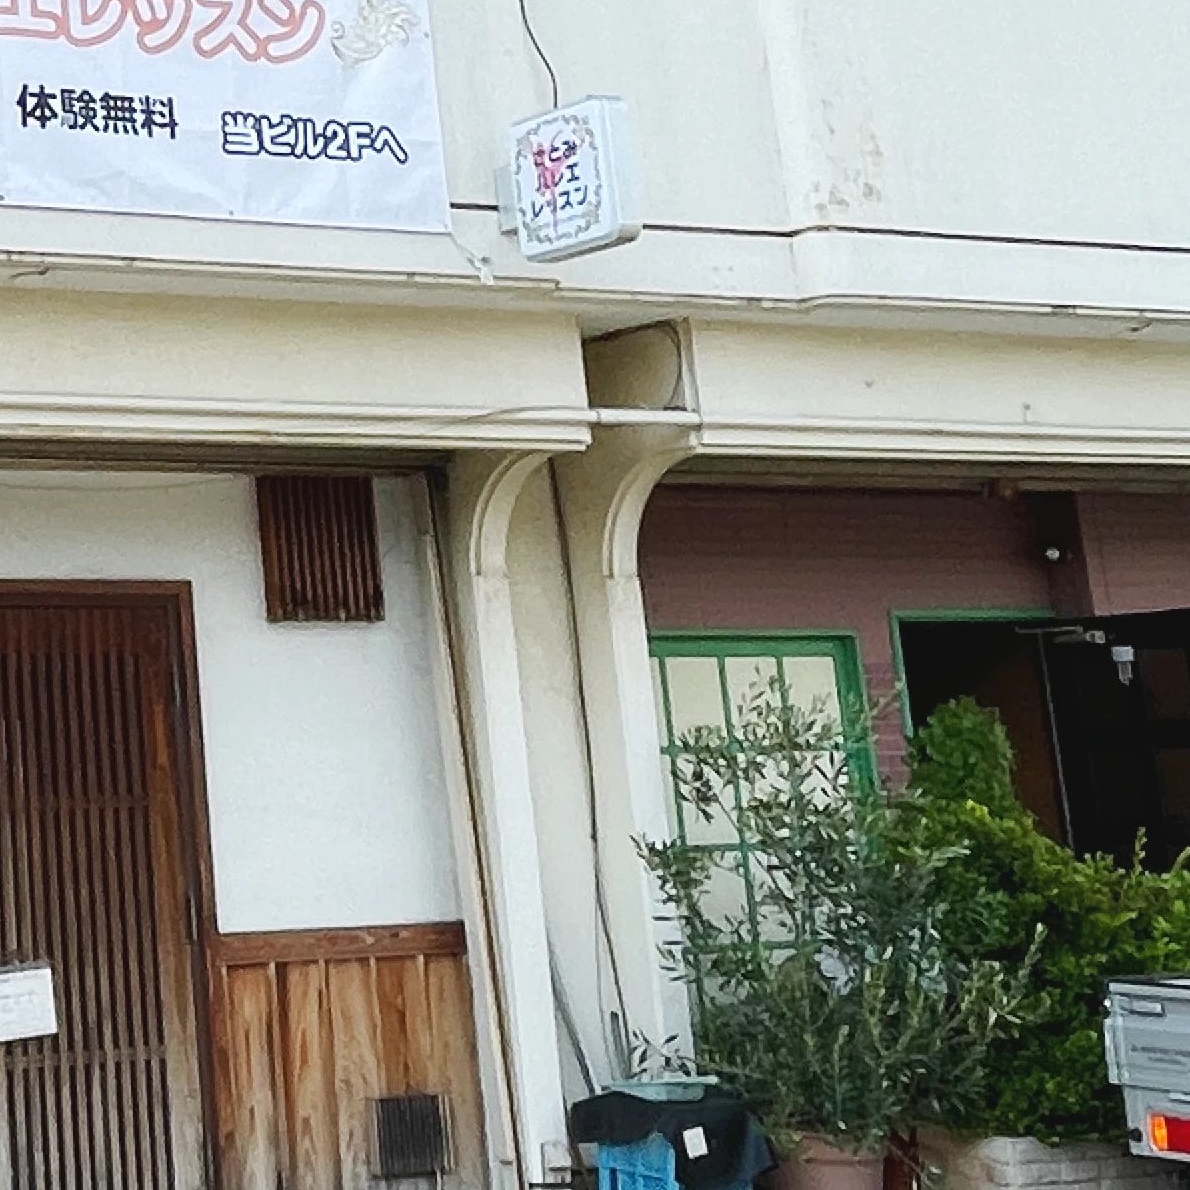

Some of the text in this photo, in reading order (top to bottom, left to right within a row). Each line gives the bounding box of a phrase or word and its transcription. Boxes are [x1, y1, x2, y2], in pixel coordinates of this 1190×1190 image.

[16, 84, 178, 140] 体験無料
[221, 111, 409, 164] 当ビル2Fへ
